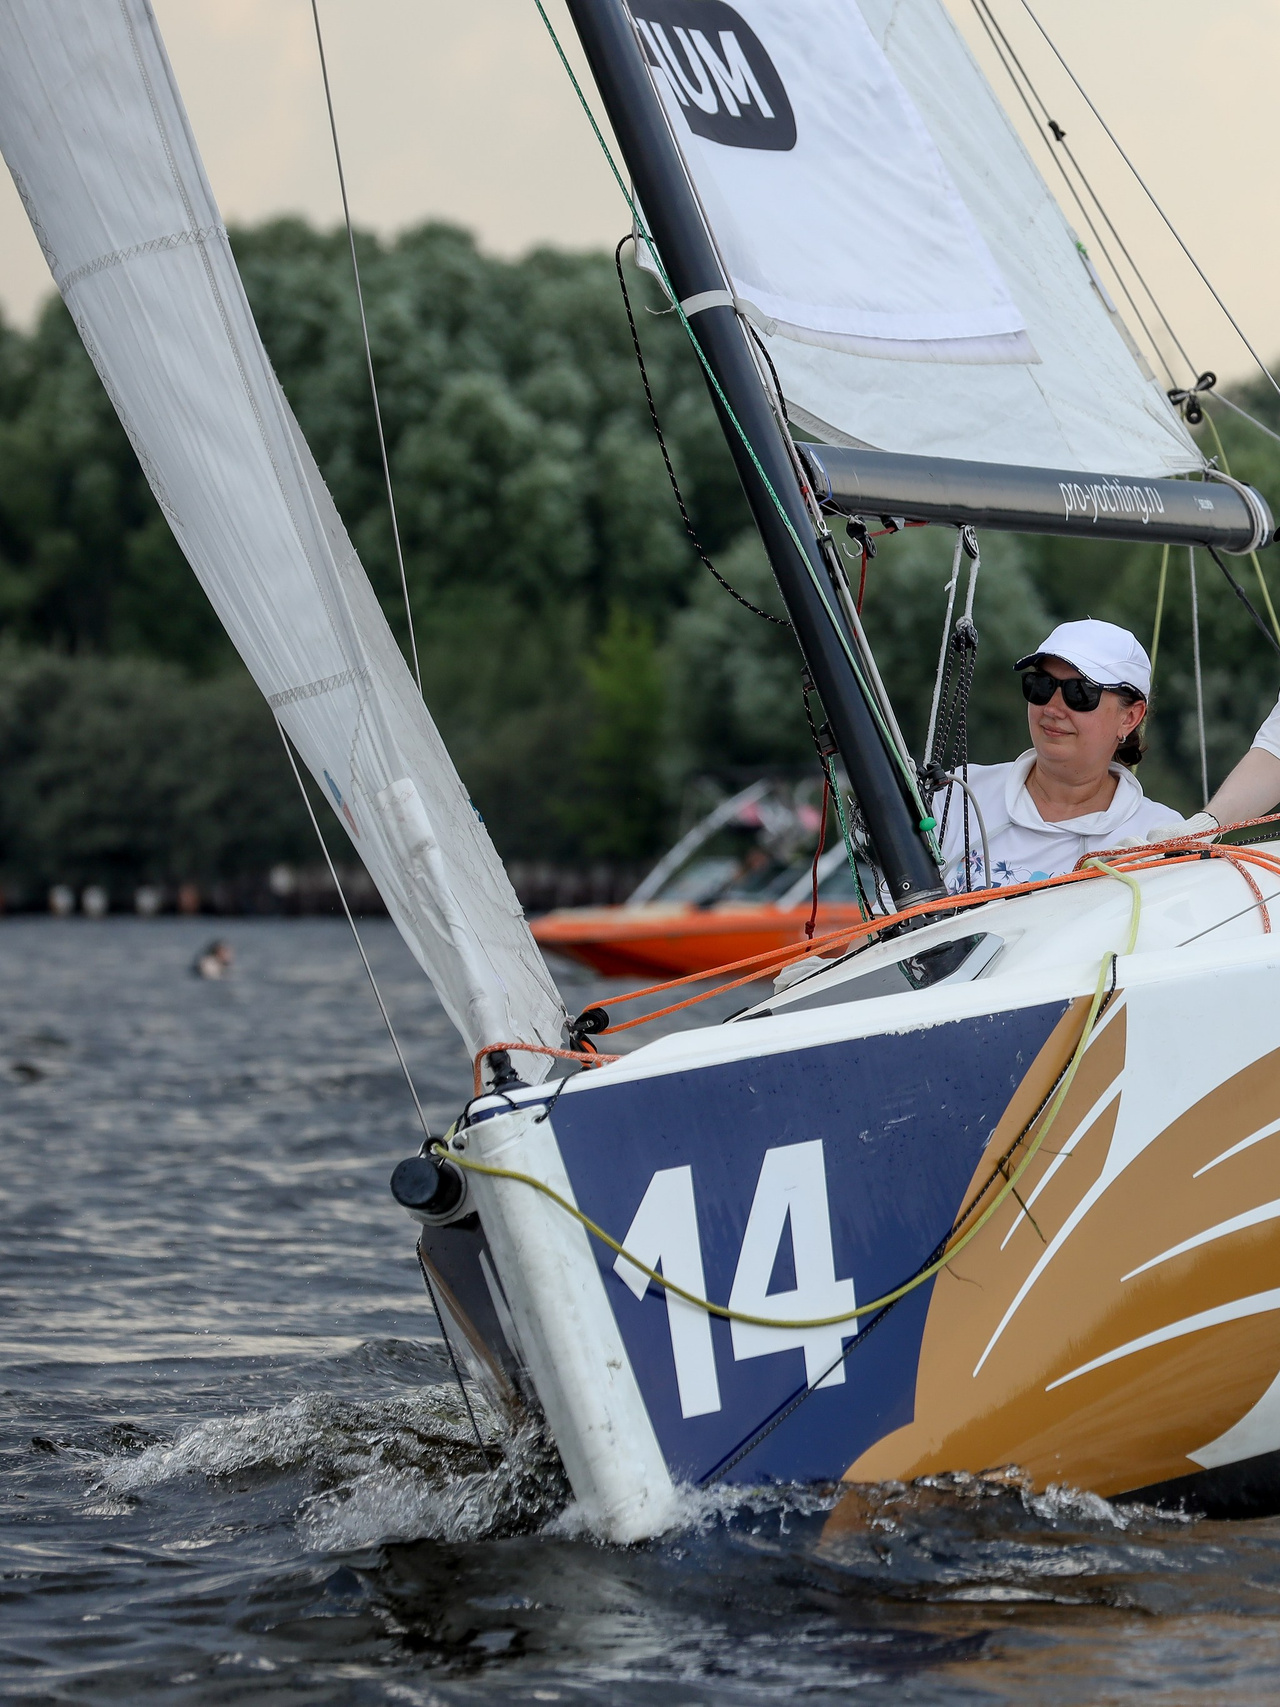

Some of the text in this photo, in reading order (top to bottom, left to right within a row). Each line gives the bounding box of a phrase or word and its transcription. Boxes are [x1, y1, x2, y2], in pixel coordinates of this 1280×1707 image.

[631, 17, 776, 119] IUM
[1058, 477, 1165, 525] pro-yachting.ru
[612, 1138, 859, 1420] 14
